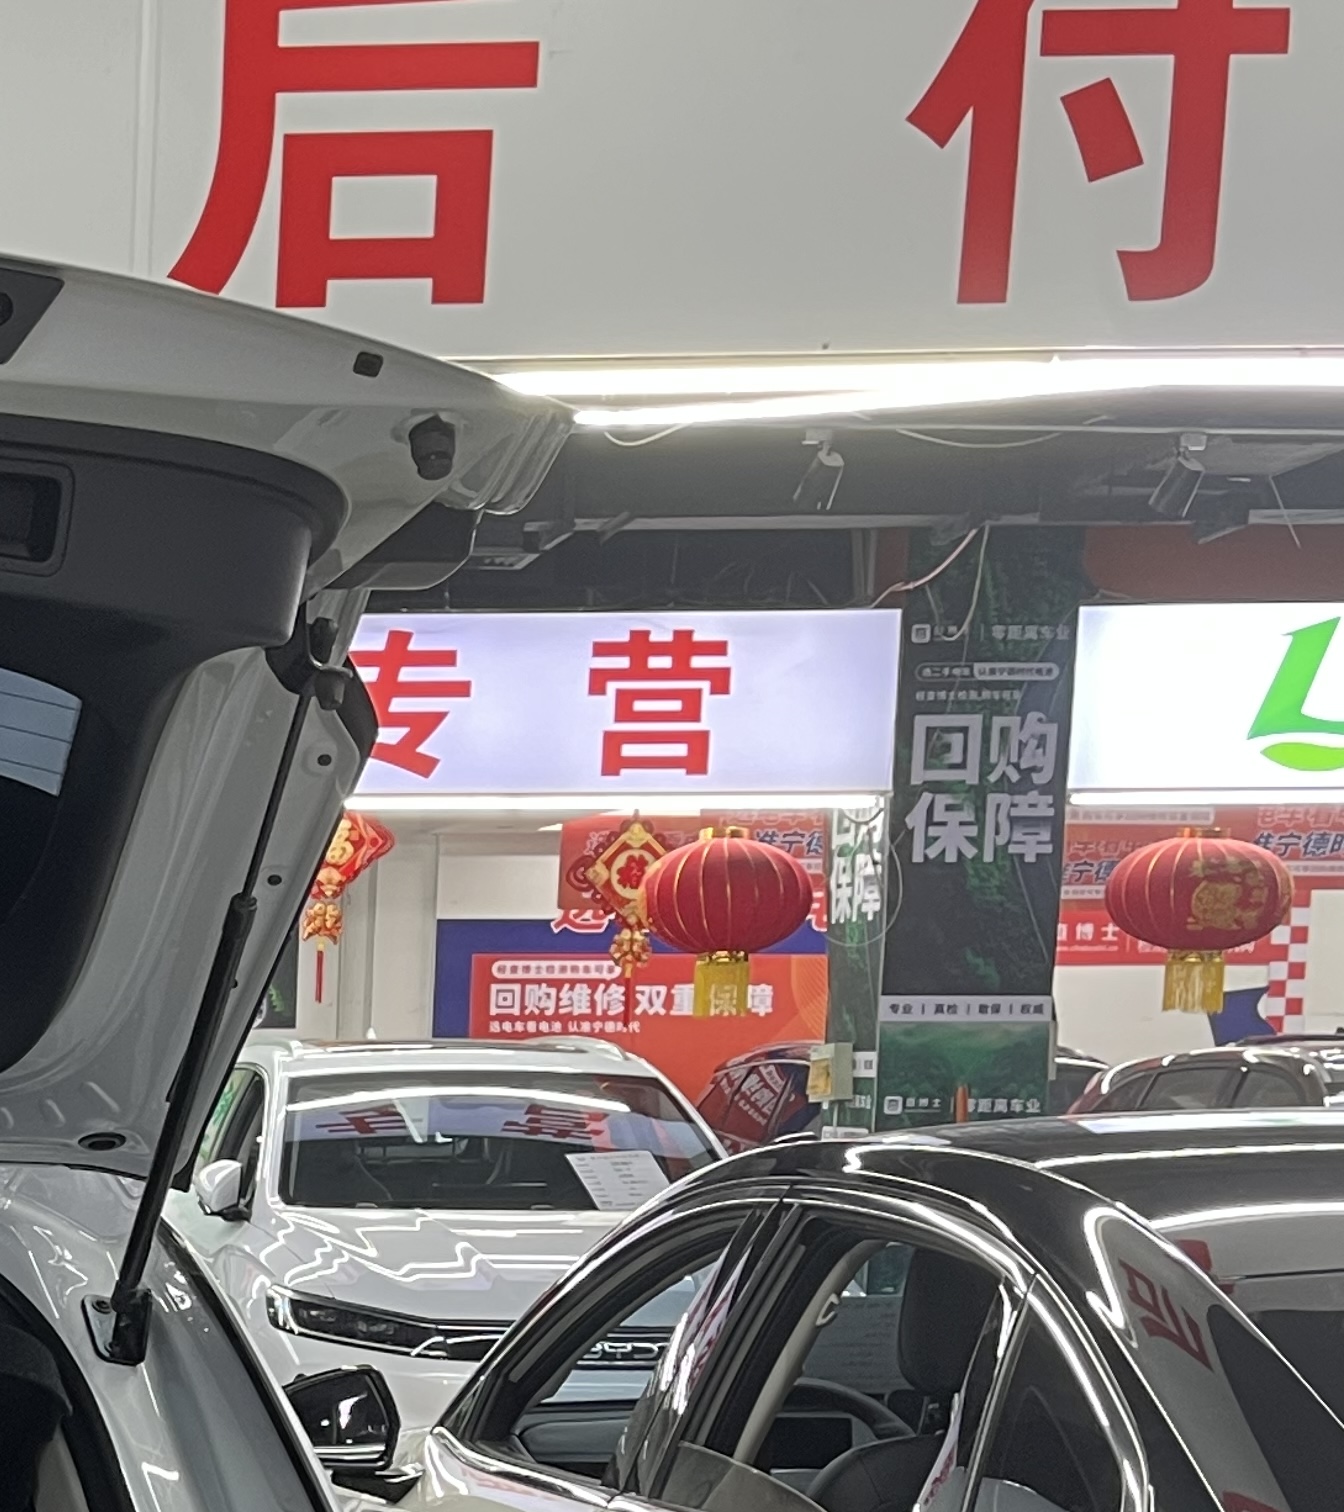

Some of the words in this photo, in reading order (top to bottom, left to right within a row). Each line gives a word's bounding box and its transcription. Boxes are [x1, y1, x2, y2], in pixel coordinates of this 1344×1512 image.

[348, 630, 732, 779] 专营
[911, 713, 1058, 785] 回购
[905, 790, 1055, 863] 保障
